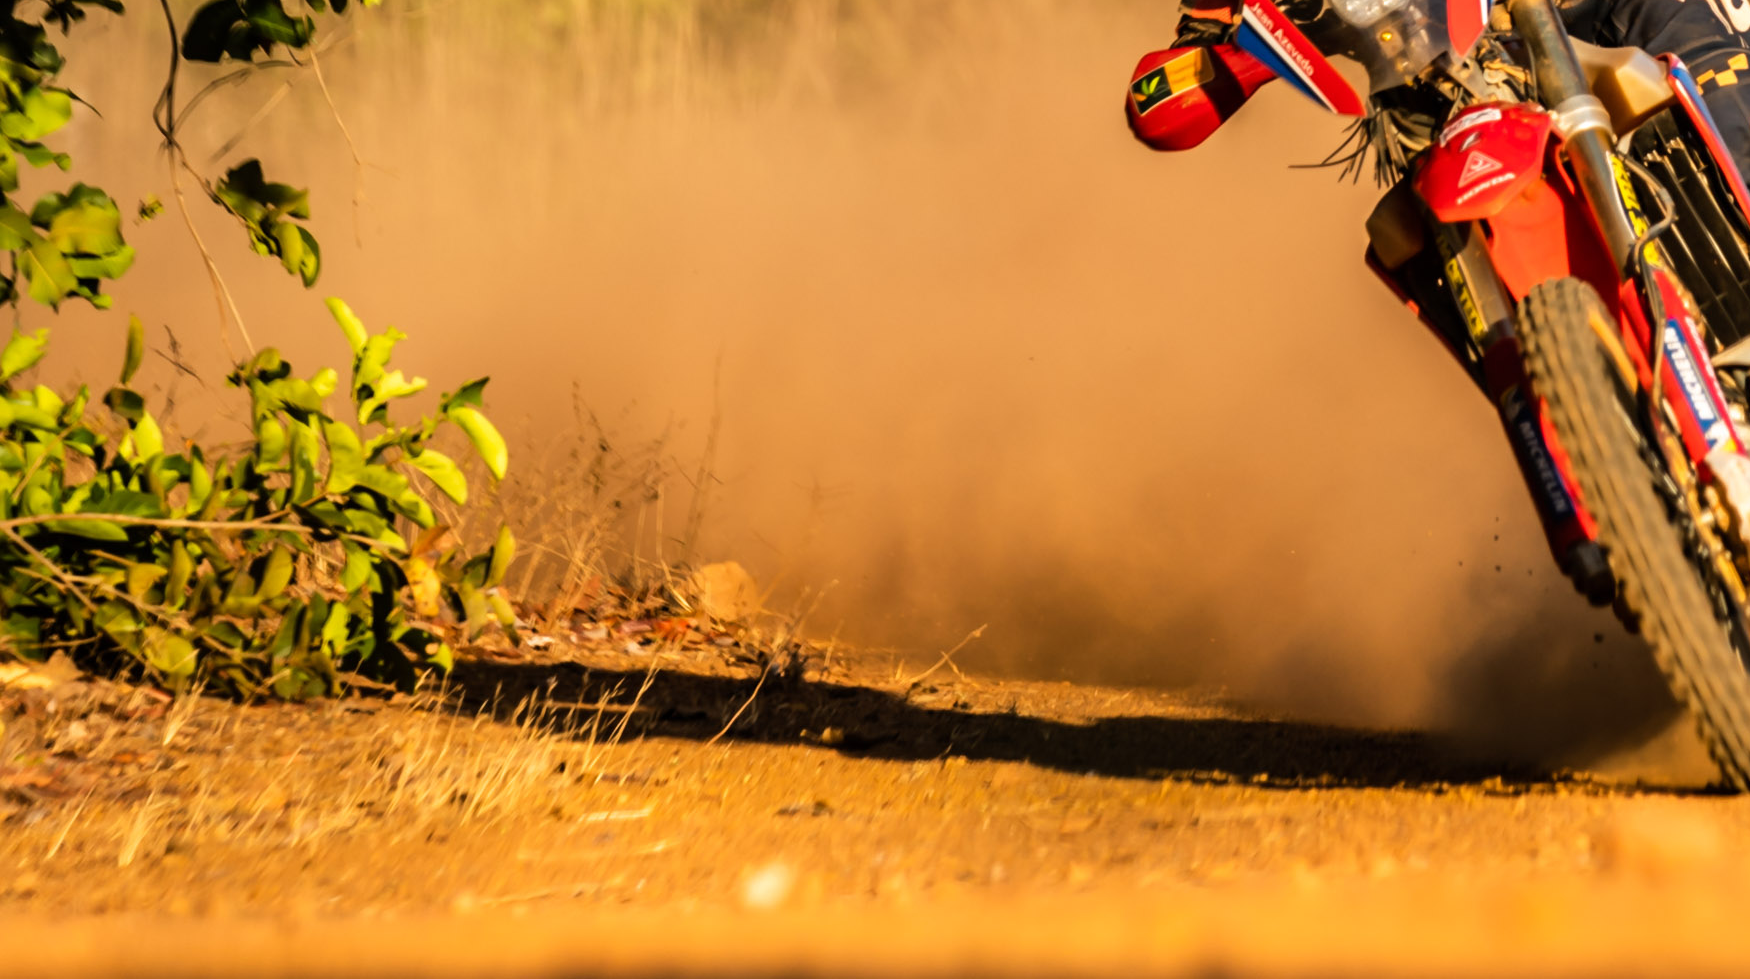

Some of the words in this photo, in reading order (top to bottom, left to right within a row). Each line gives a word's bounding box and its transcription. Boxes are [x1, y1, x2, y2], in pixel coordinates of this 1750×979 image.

[1251, 2, 1274, 31] Jean
[1274, 28, 1314, 77] Azevedo
[1663, 327, 1716, 420] MICHELIN
[1519, 421, 1568, 512] MICHELIN
